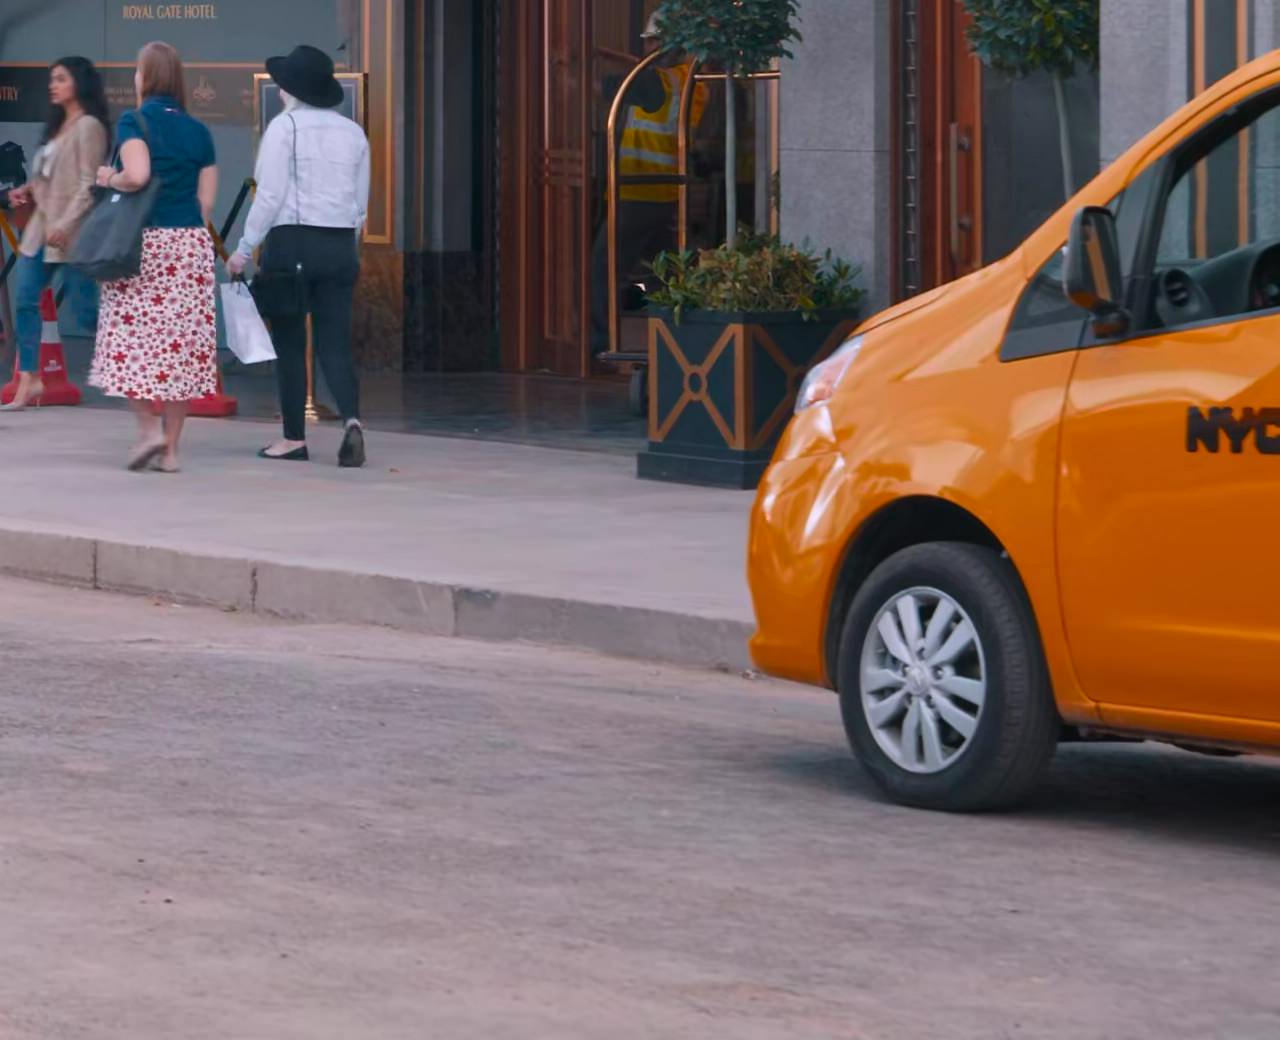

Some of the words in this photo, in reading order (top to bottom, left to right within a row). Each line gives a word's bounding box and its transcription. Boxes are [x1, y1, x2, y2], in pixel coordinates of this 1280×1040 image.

[122, 4, 154, 20] ROYAL
[156, 4, 182, 20] GATE
[184, 4, 217, 20] HOTEL
